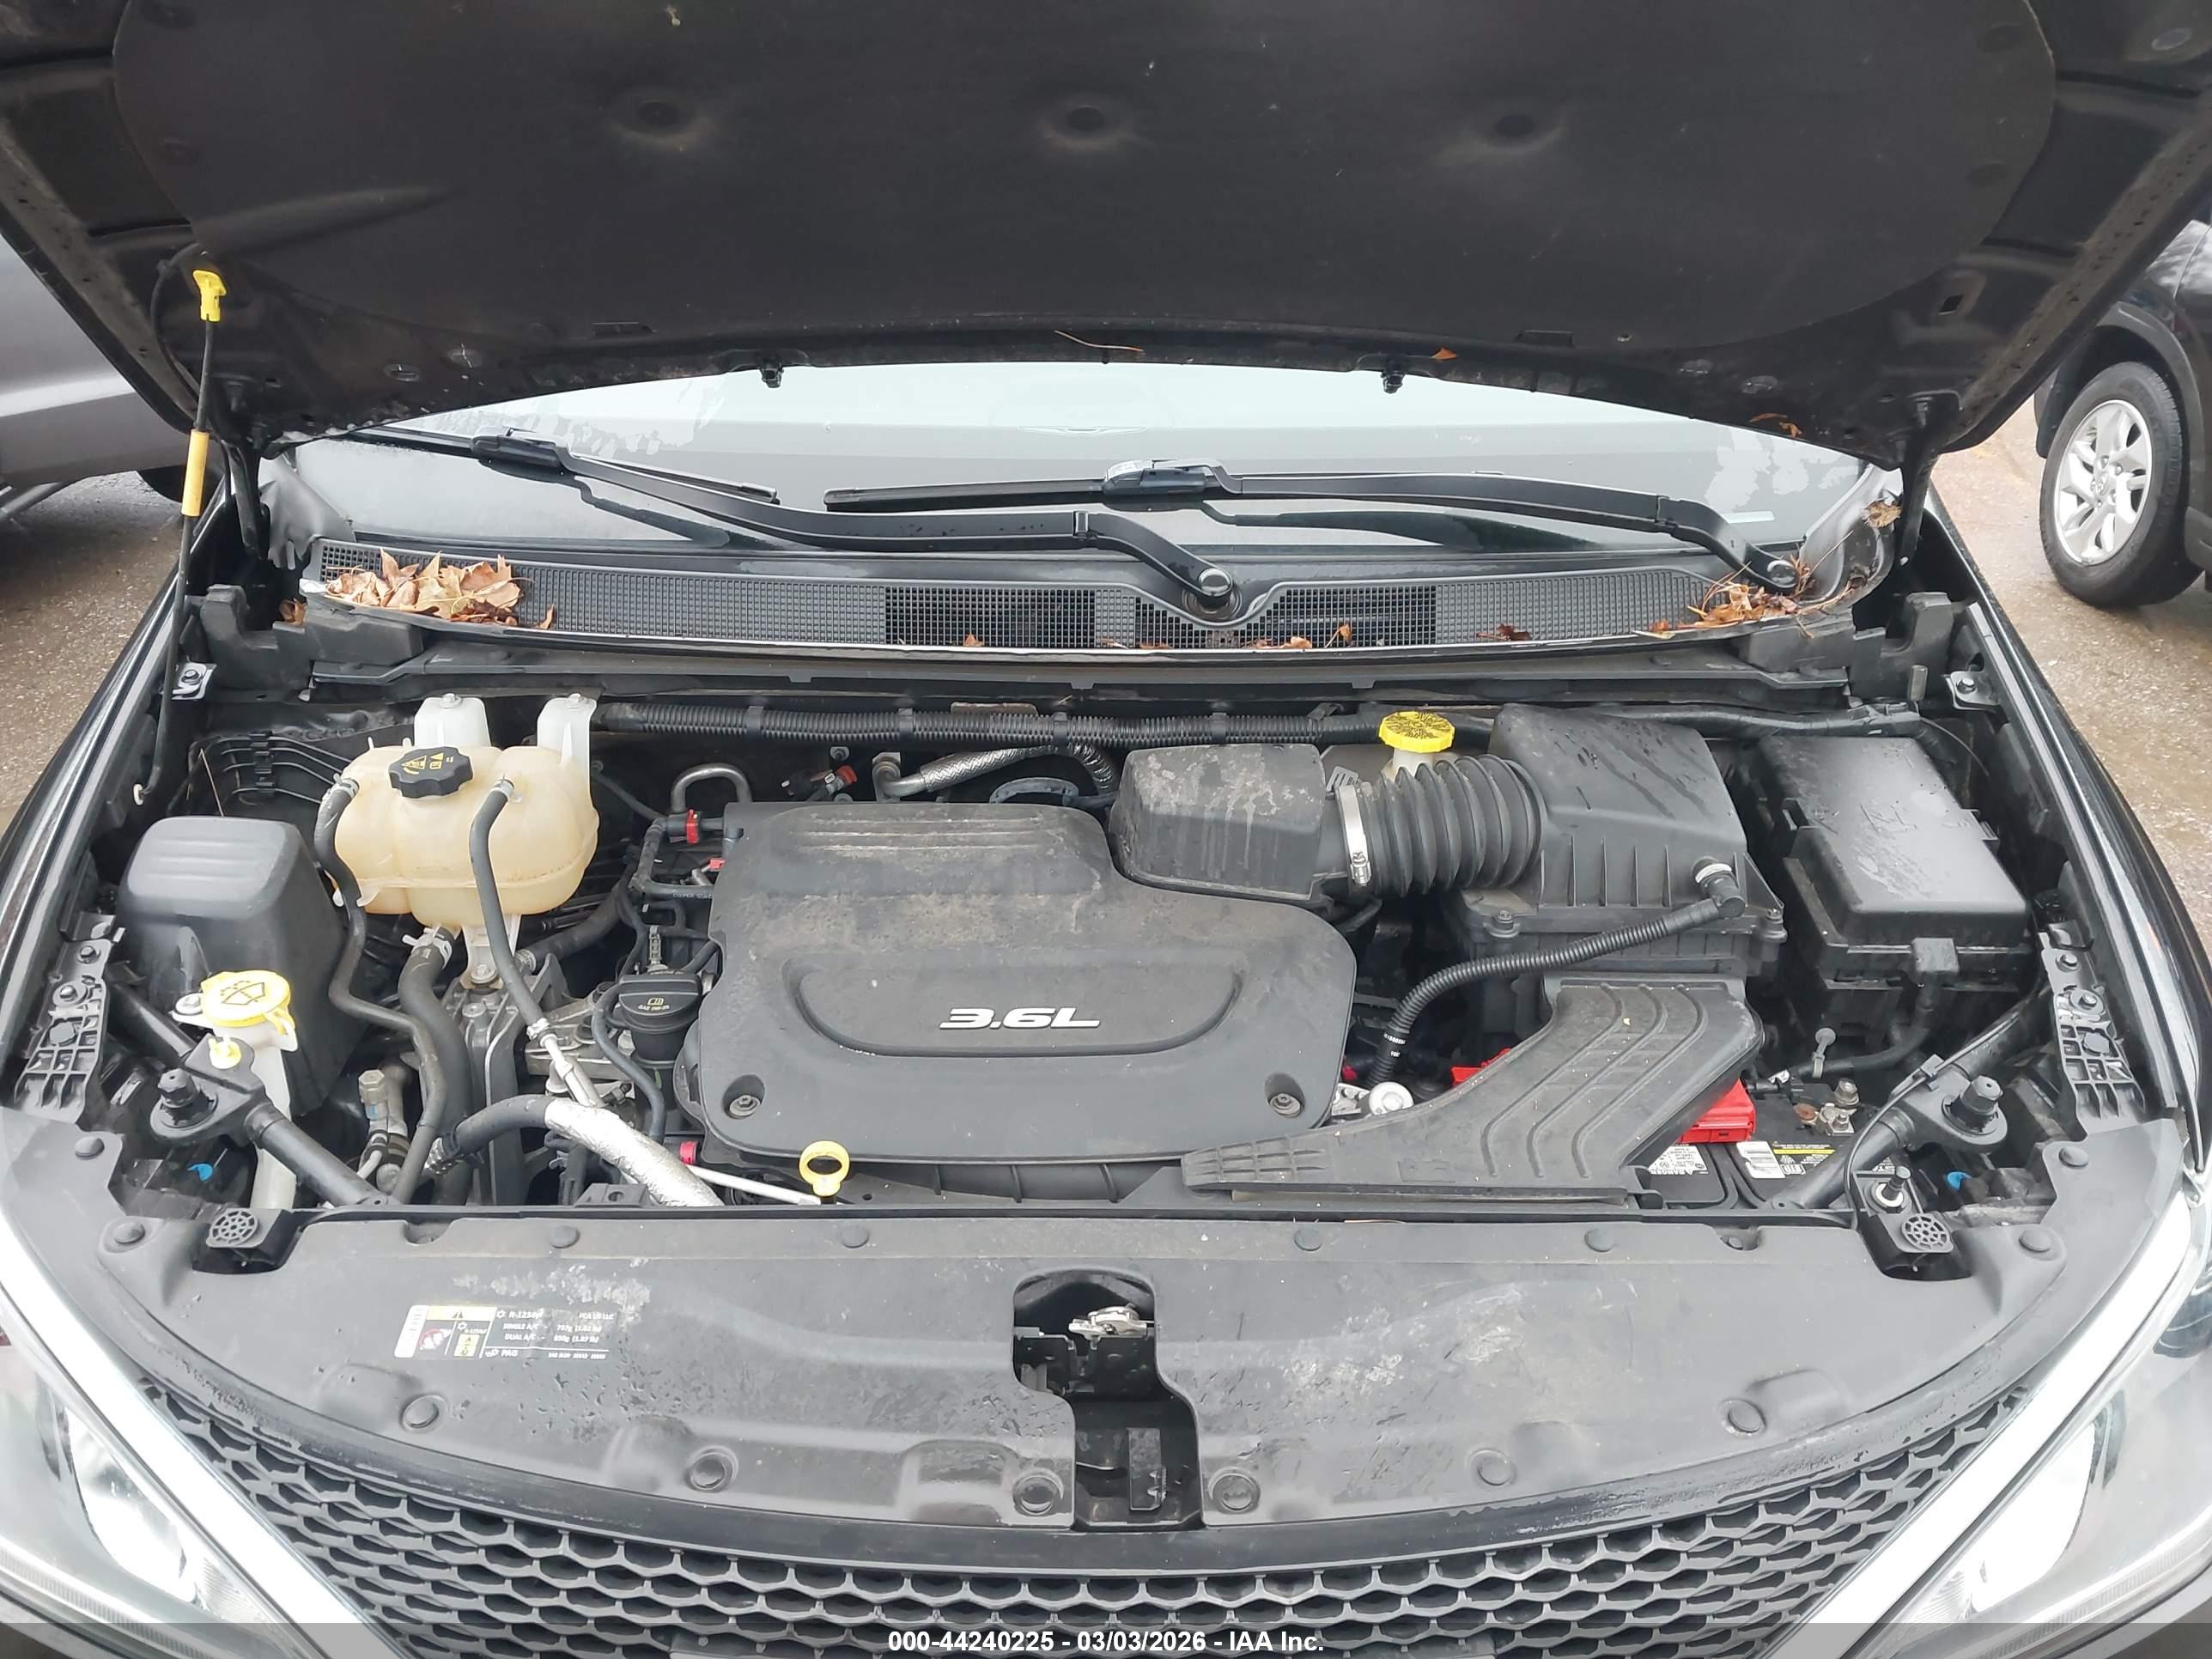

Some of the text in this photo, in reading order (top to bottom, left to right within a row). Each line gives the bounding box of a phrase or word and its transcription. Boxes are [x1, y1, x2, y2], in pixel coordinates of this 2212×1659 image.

[939, 1006, 1101, 1030] 3.6L
[579, 1311, 592, 1320] FCA
[526, 1322, 539, 1331] A/C
[523, 1333, 537, 1341] A/C
